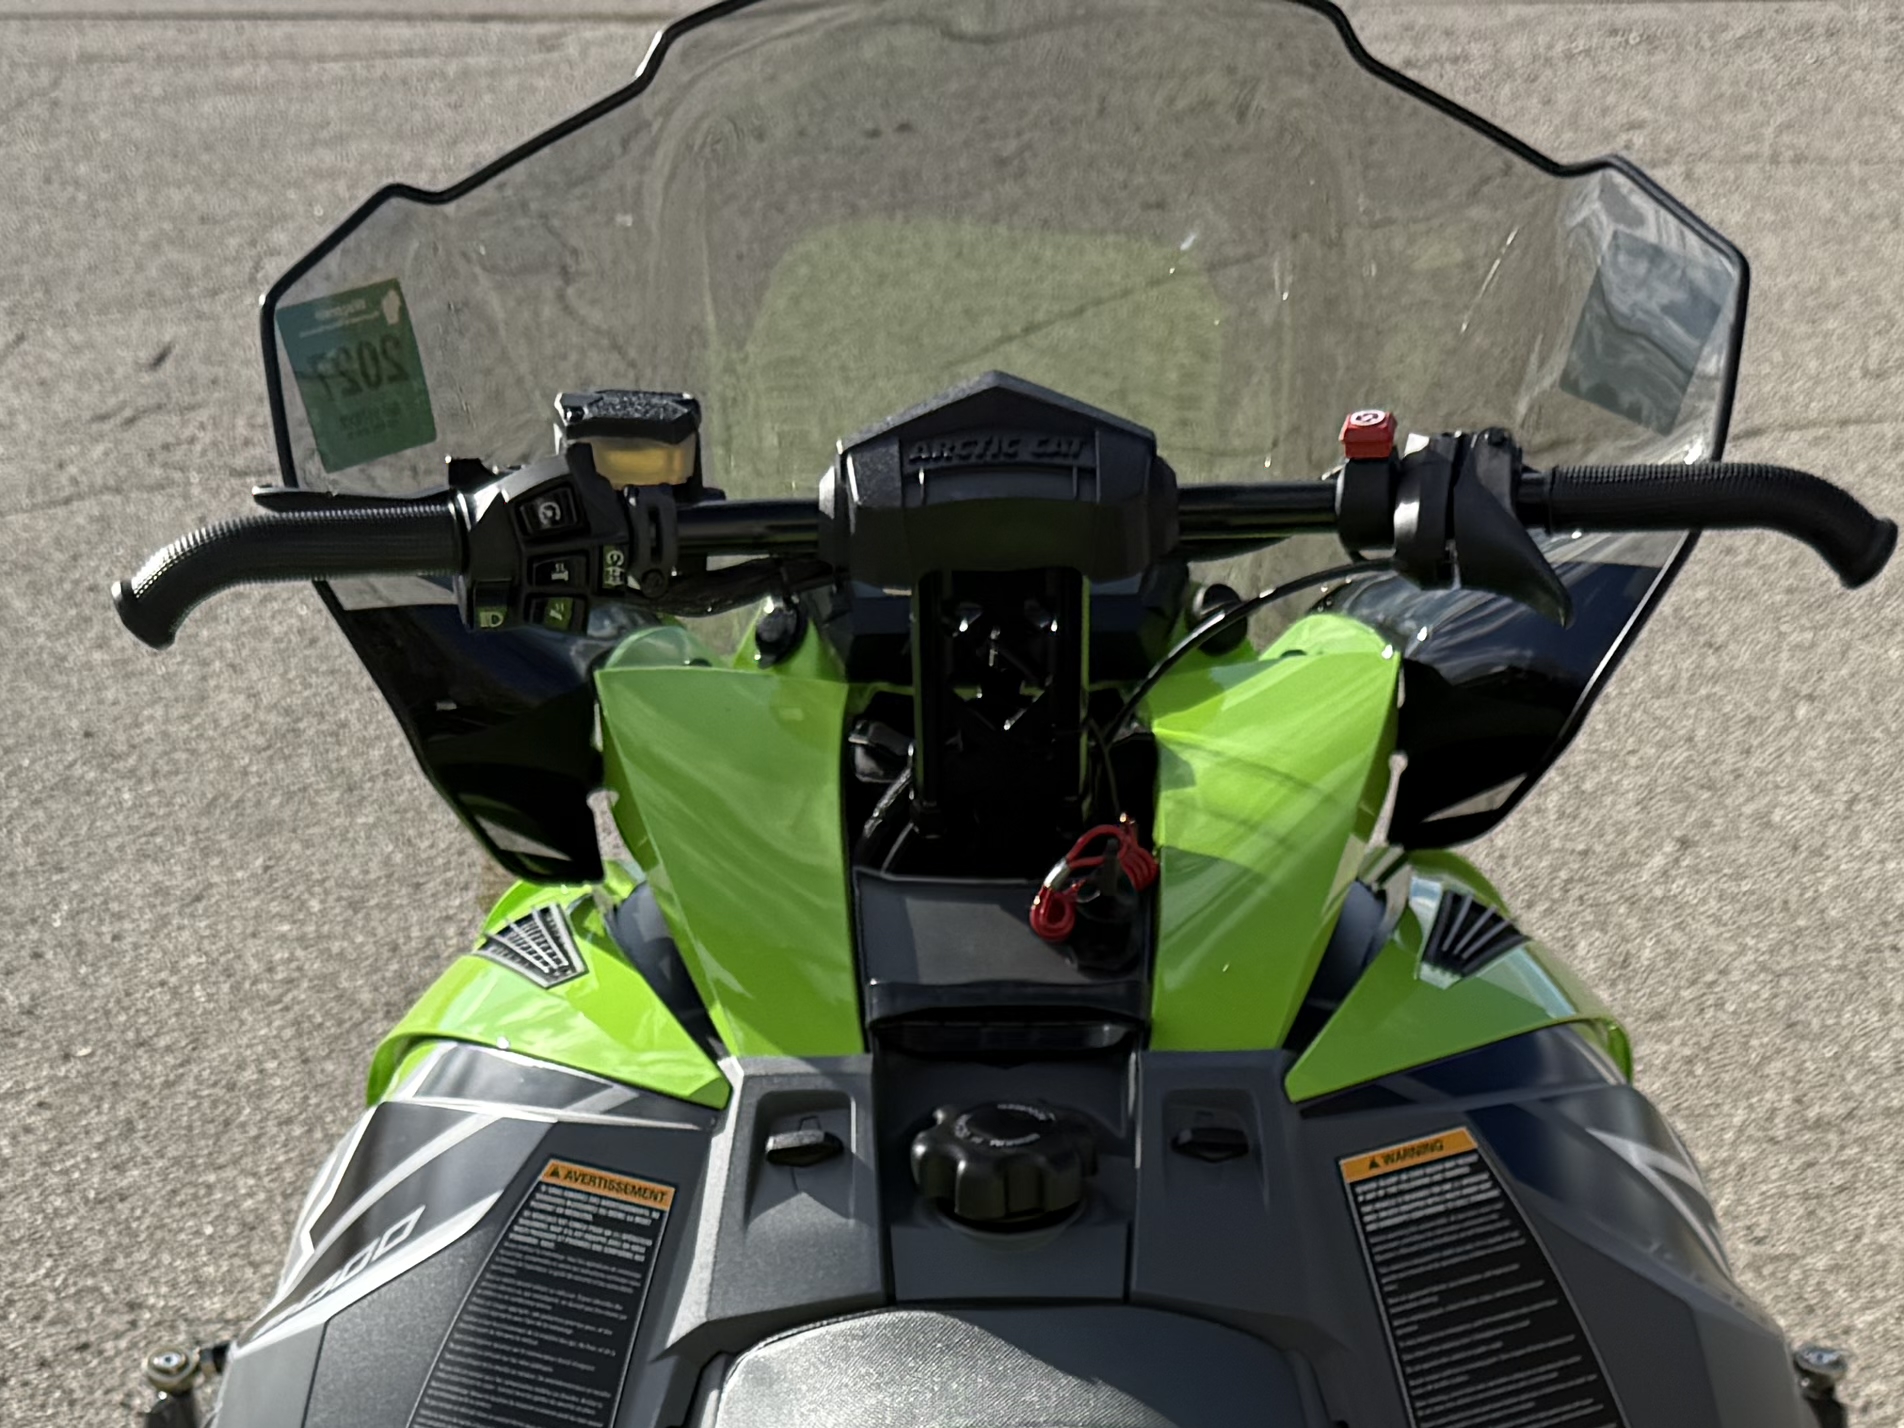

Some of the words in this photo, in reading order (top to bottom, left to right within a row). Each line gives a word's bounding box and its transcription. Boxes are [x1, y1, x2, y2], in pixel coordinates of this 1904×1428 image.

[908, 437, 1022, 464] ARCTIC
[1030, 437, 1088, 460] CAT
[1382, 1140, 1445, 1166] WARNING
[564, 1168, 669, 1203] AVERTISSEMENT
